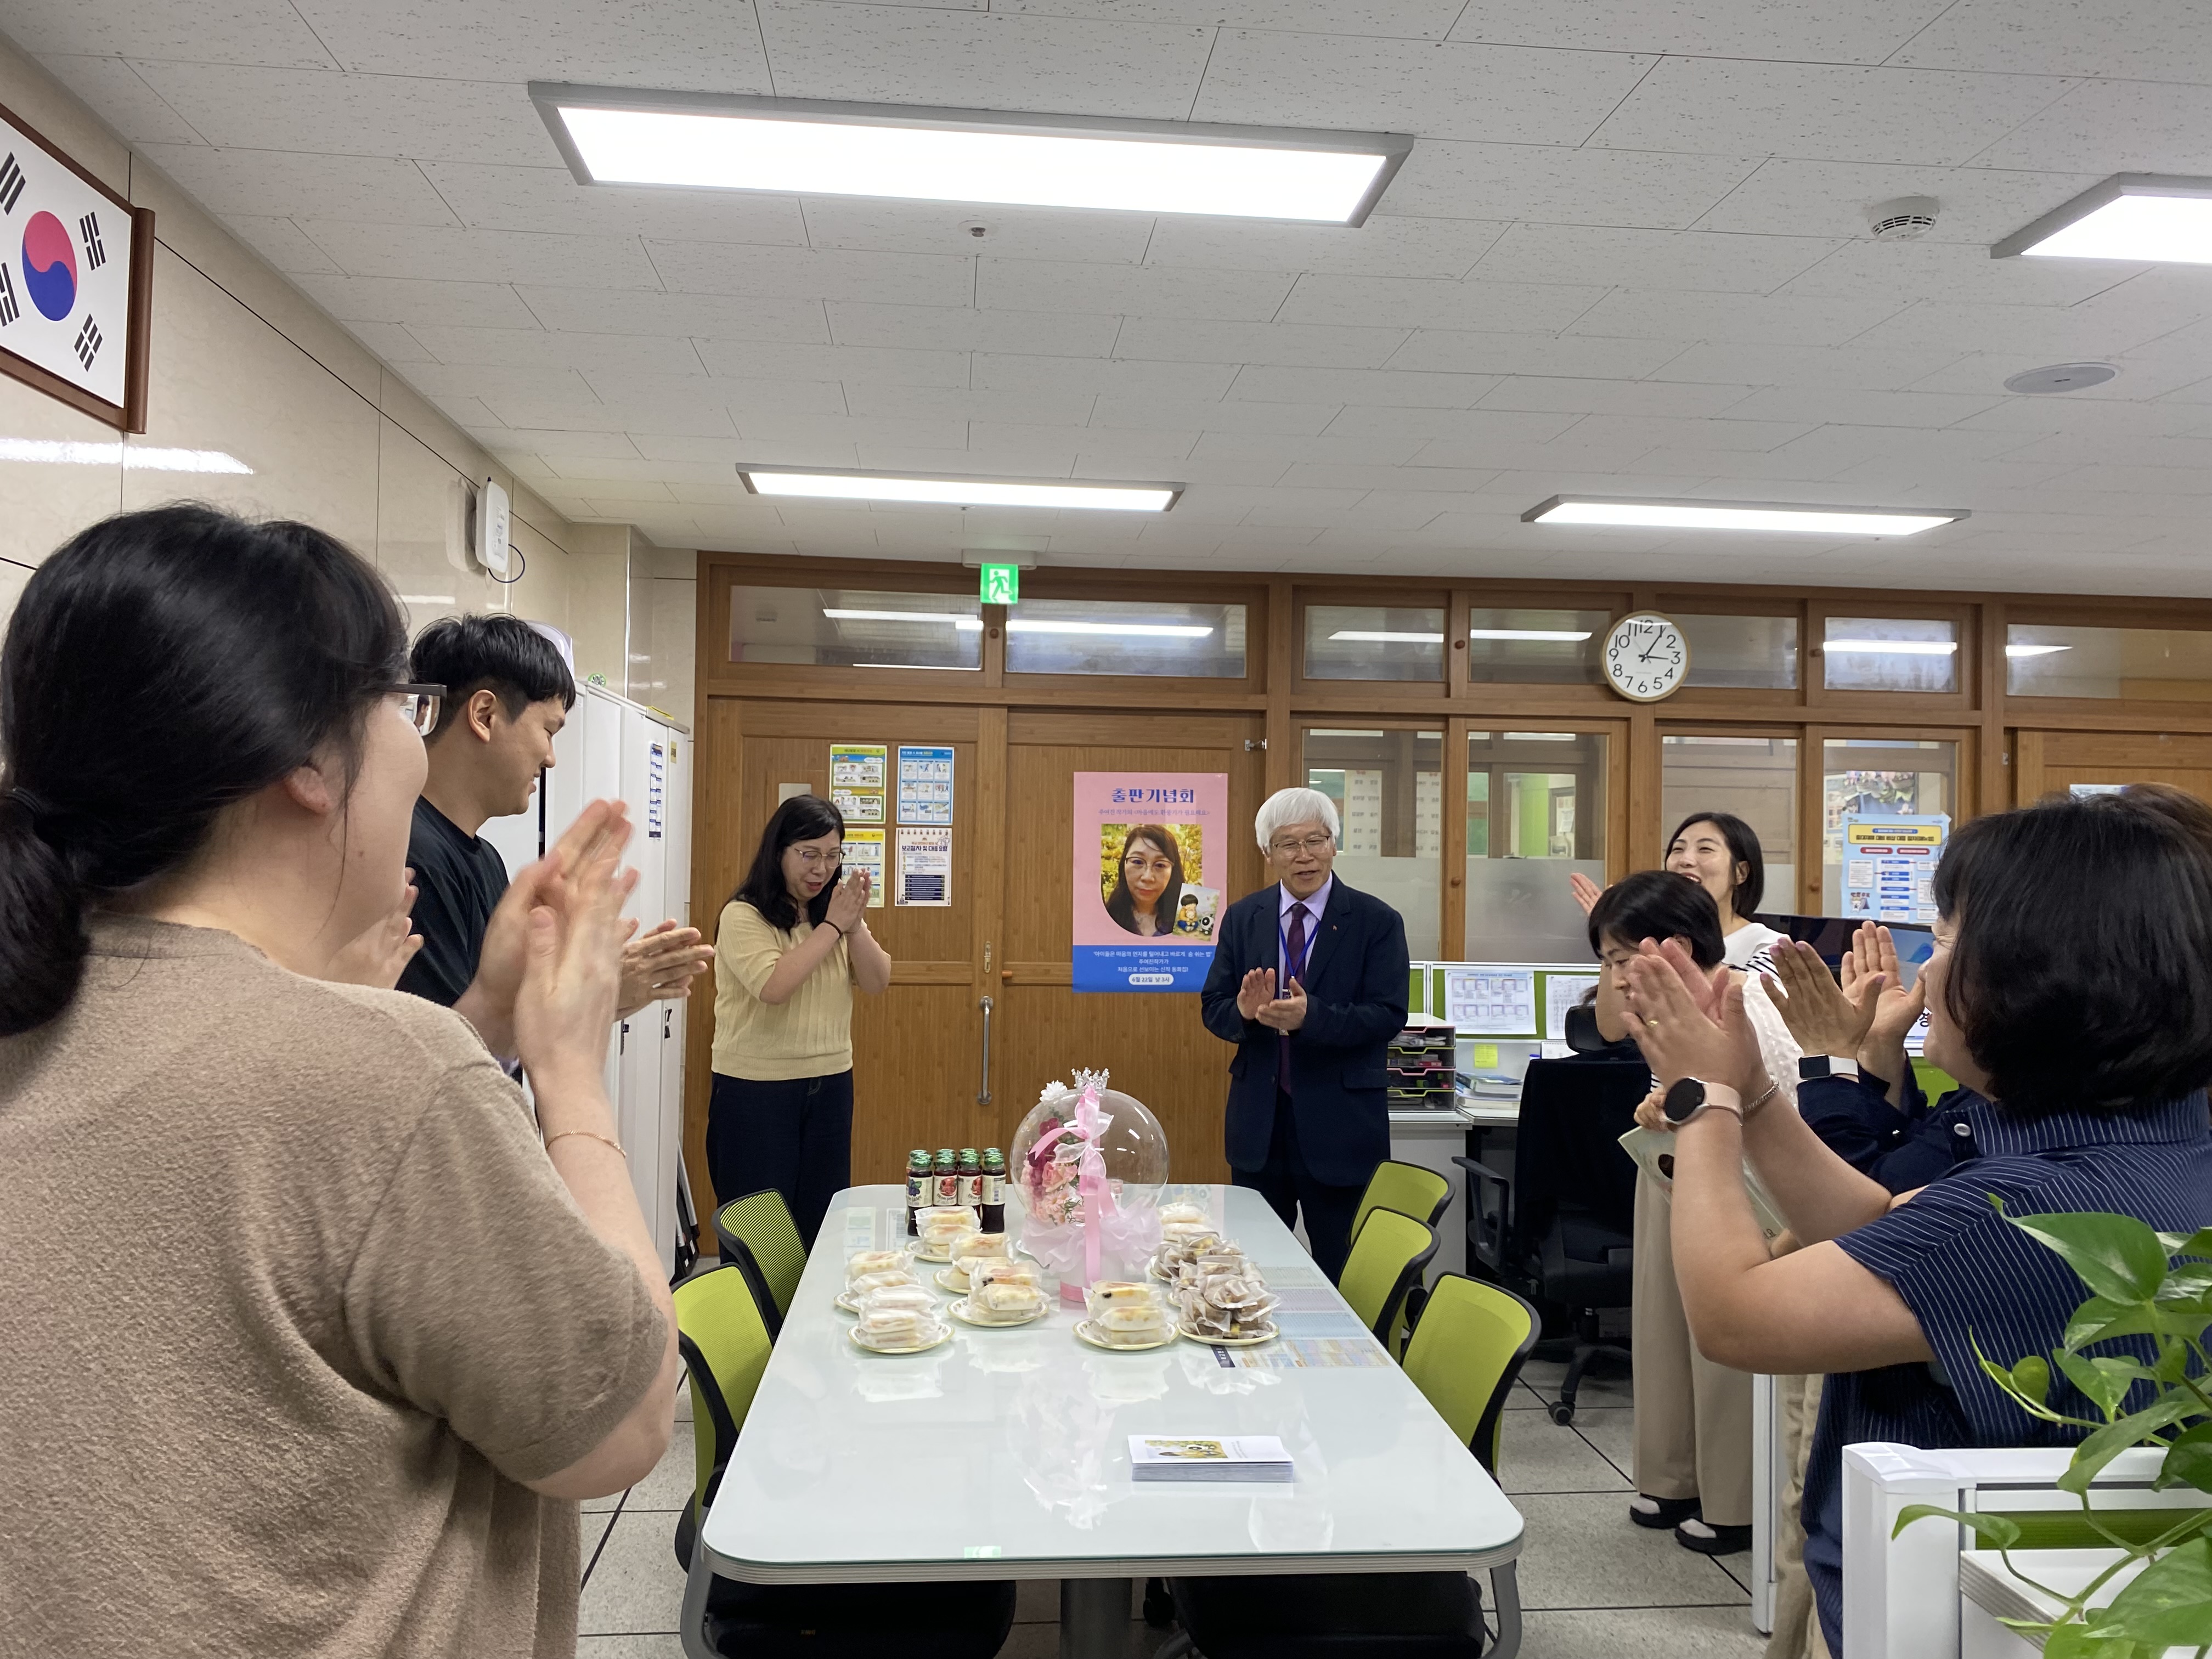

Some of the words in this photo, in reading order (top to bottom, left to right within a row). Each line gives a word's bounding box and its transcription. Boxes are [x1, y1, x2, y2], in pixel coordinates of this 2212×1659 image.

[1628, 623, 1638, 636] 11
[1639, 619, 1653, 634] 12
[1615, 635, 1630, 648] 10
[1666, 634, 1676, 648] 2
[1609, 648, 1619, 661] 9
[1671, 651, 1680, 664] 3
[1612, 663, 1622, 677] 8
[1664, 667, 1673, 679] 4
[1625, 676, 1633, 688] 7
[1638, 680, 1647, 693] 6
[1653, 677, 1662, 690] 5
[1111, 788, 1194, 803] 출판기념회
